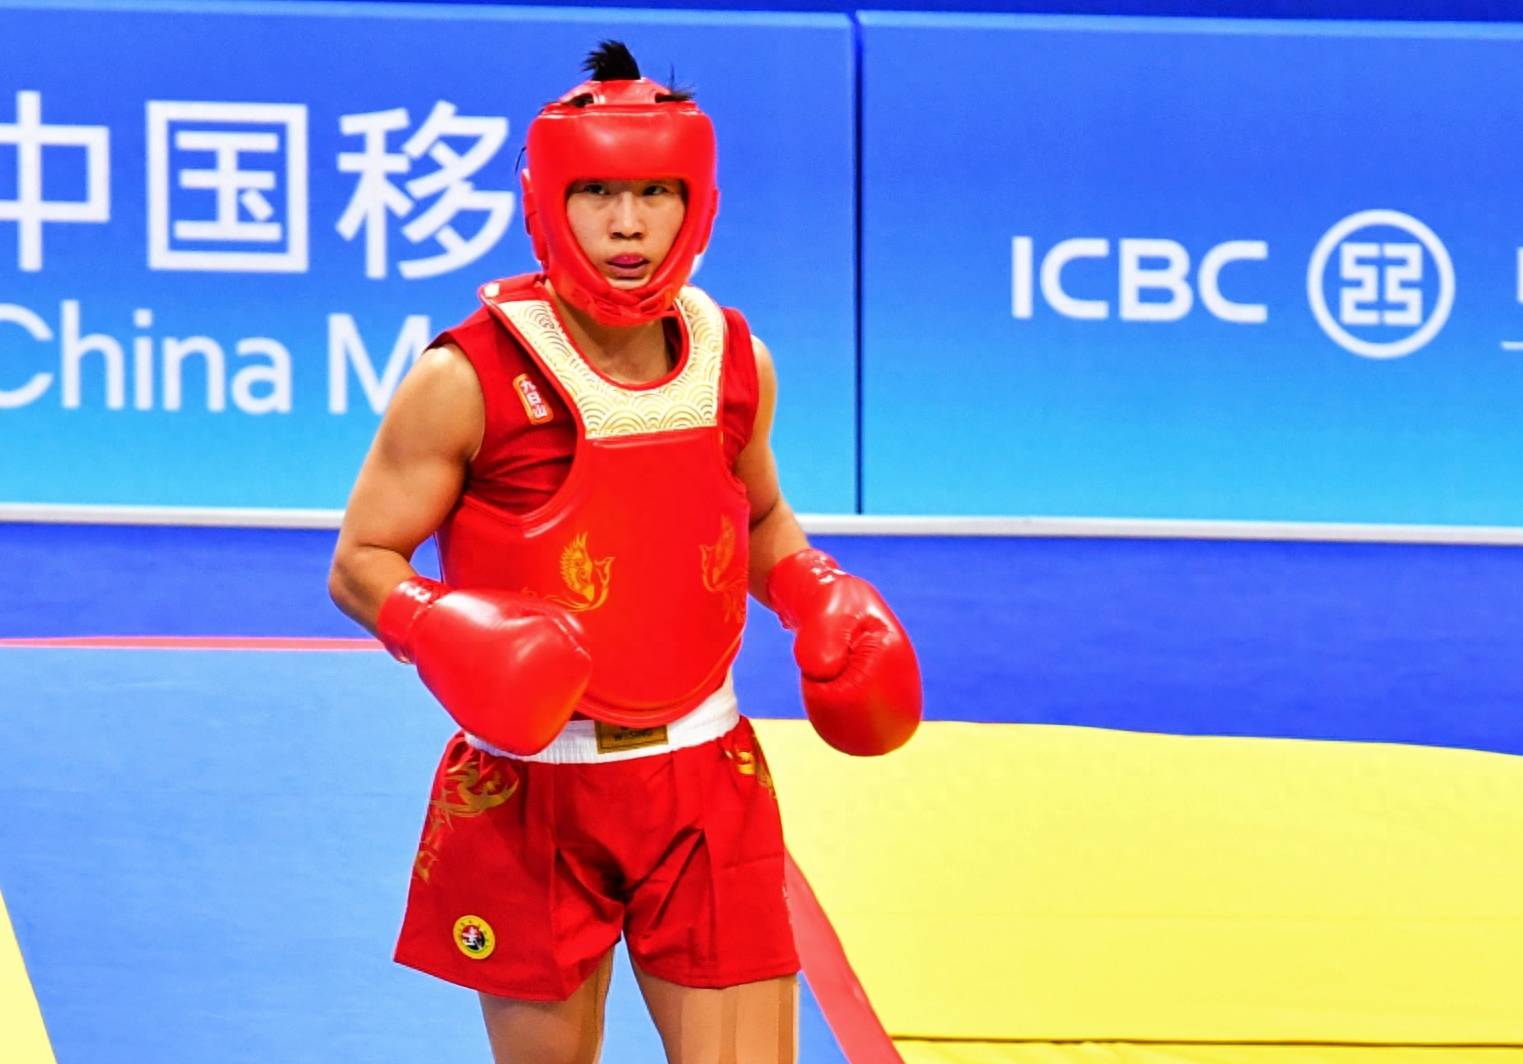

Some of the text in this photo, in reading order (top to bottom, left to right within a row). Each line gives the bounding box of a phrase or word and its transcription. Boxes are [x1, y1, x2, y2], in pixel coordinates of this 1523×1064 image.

[0, 90, 516, 280] 中国移
[1011, 235, 1268, 324] ICBC
